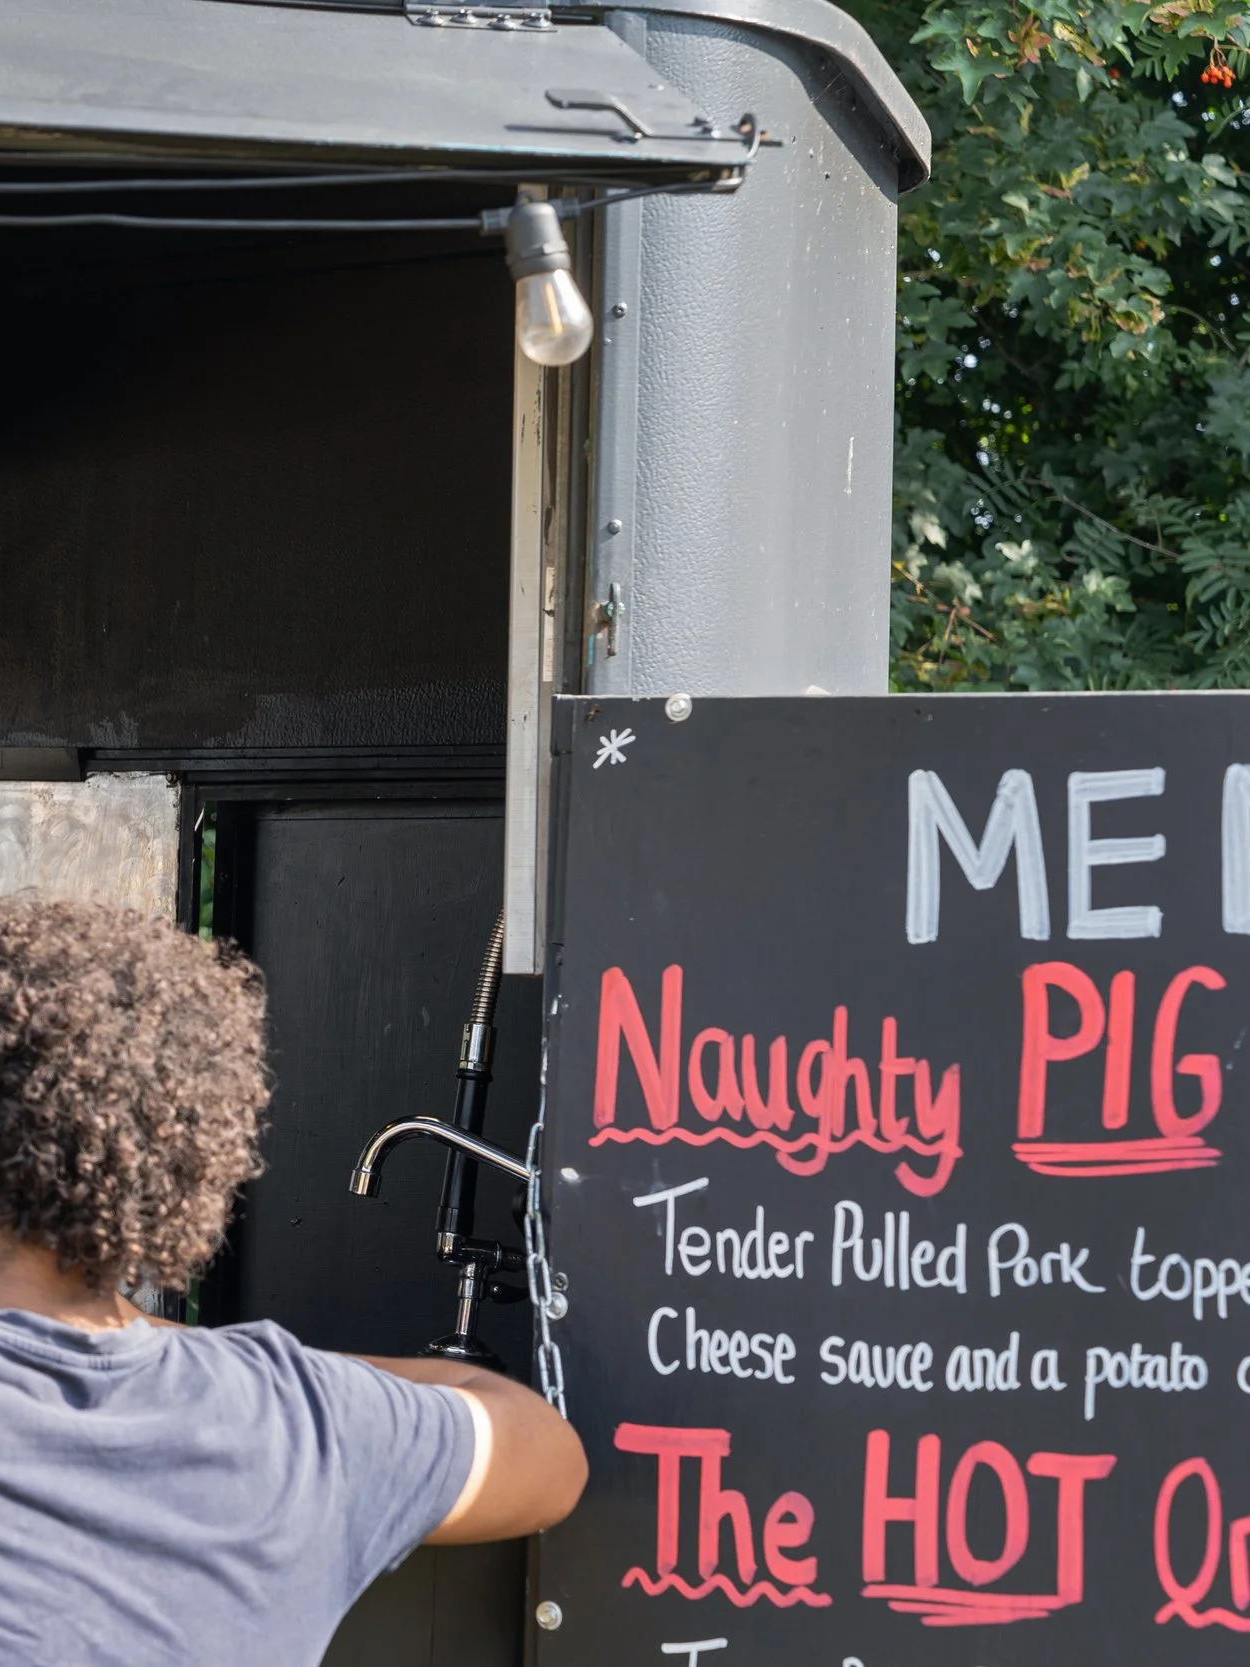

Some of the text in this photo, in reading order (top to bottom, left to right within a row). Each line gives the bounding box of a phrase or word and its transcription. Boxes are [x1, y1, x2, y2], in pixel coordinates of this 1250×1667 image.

[906, 764, 1250, 943] ME
[594, 961, 1227, 1197] Naughty PIG
[633, 1177, 815, 1280] Tender
[831, 1200, 968, 1294] Pulled
[987, 1222, 1107, 1297] Pork
[647, 1306, 797, 1384] Cheese
[819, 1336, 934, 1392] sauce
[946, 1331, 1022, 1392] and
[1030, 1349, 1068, 1391] a
[1084, 1341, 1209, 1421] potato
[613, 1422, 819, 1585] The
[861, 1429, 1118, 1603] HOT
